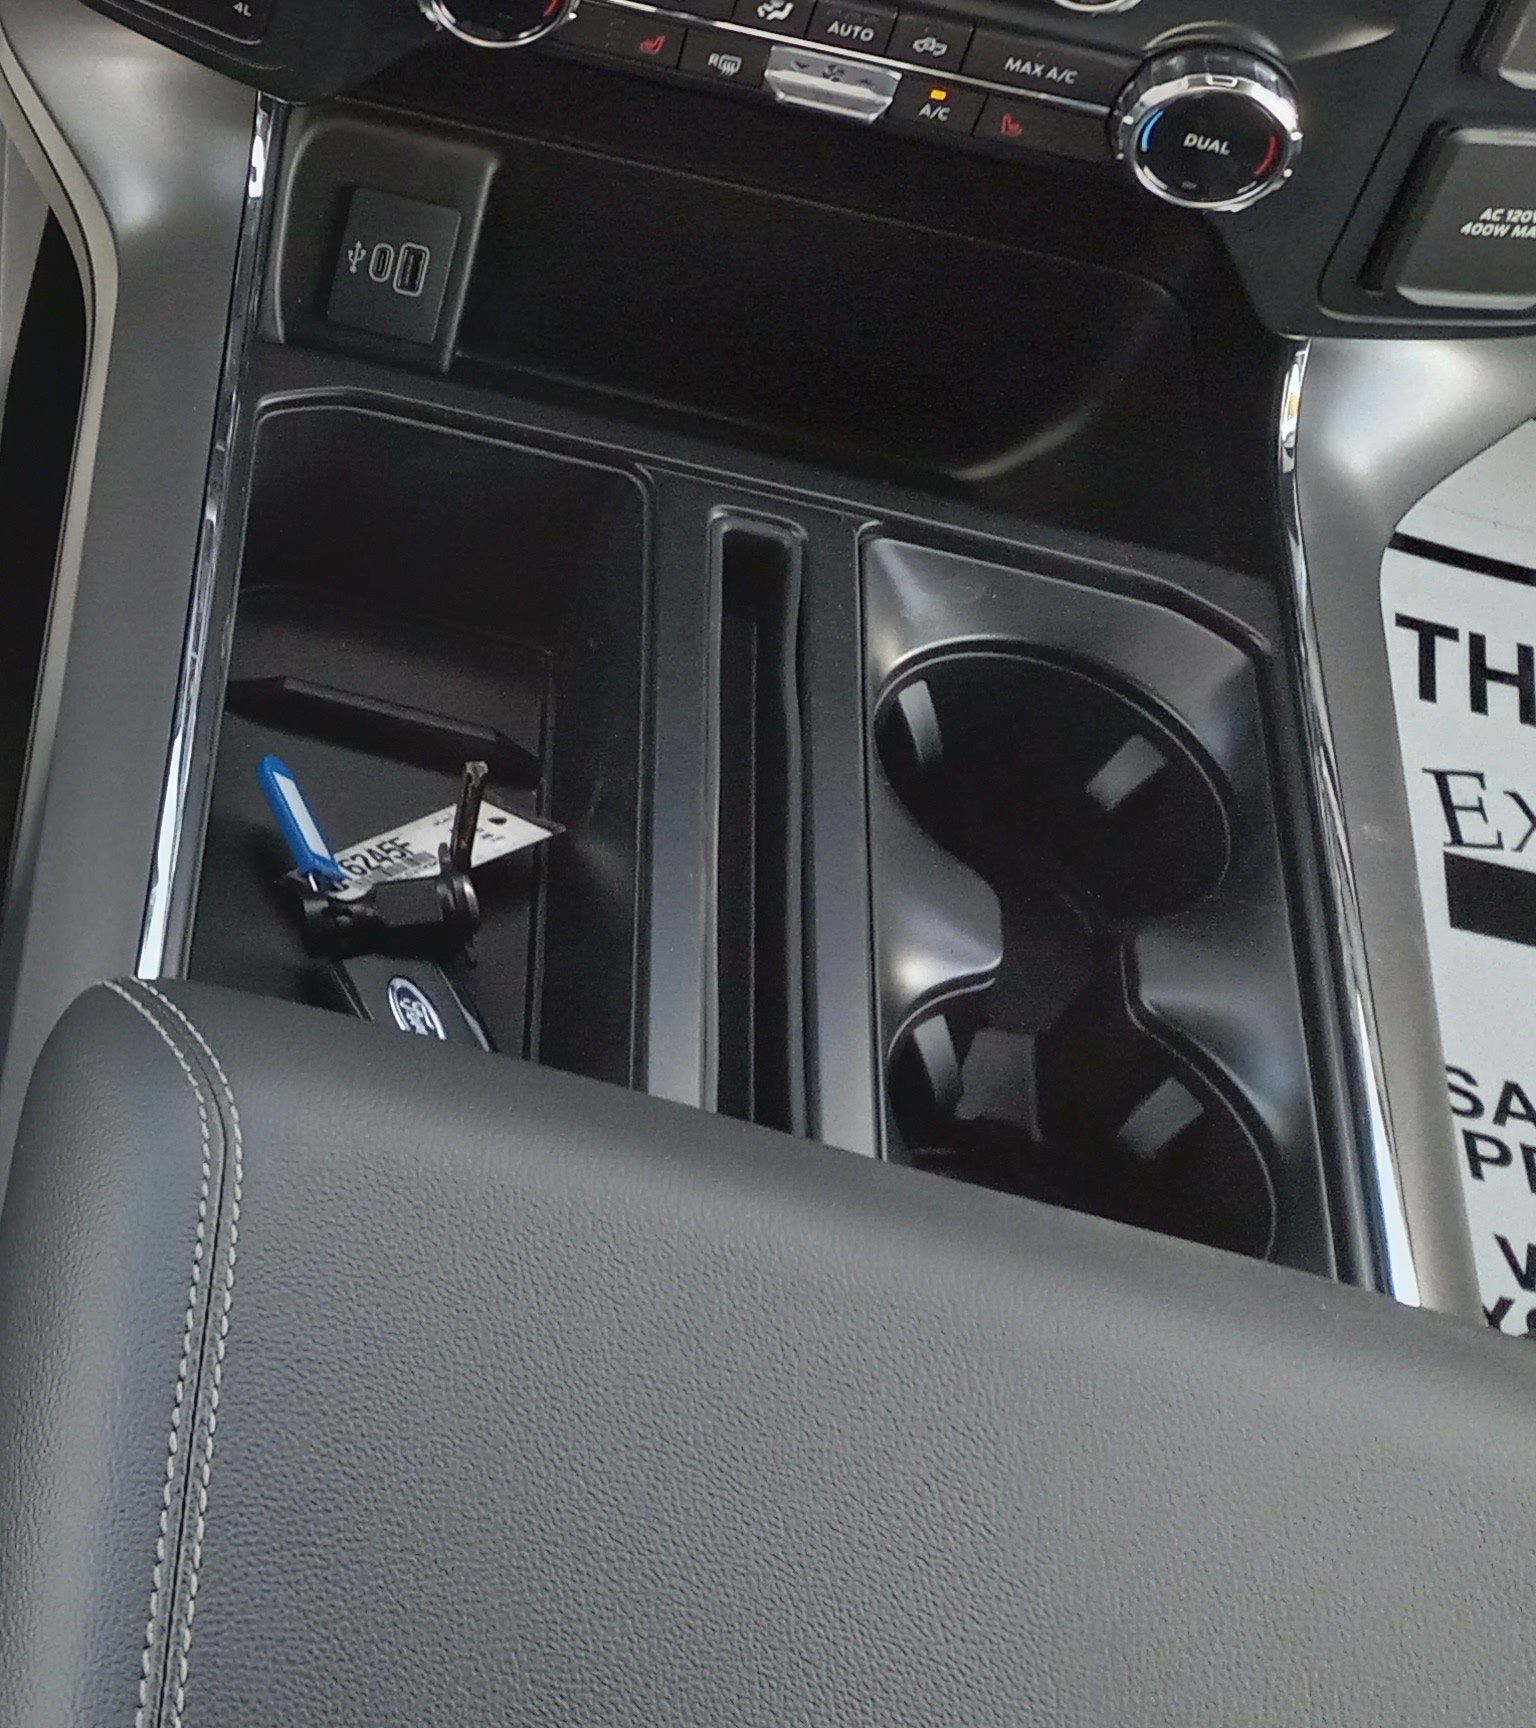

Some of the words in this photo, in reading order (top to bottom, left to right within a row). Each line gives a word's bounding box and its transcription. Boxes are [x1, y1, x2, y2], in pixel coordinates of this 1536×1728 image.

[232, 1, 252, 17] 4L
[827, 21, 875, 43] AUTO
[1004, 56, 1045, 80] MAX
[1045, 65, 1078, 87] A/C
[918, 104, 951, 123] A/C
[1183, 132, 1230, 156] DUAL
[1479, 208, 1505, 221] AC
[1460, 221, 1510, 238] 400W
[1394, 612, 1536, 728] TH
